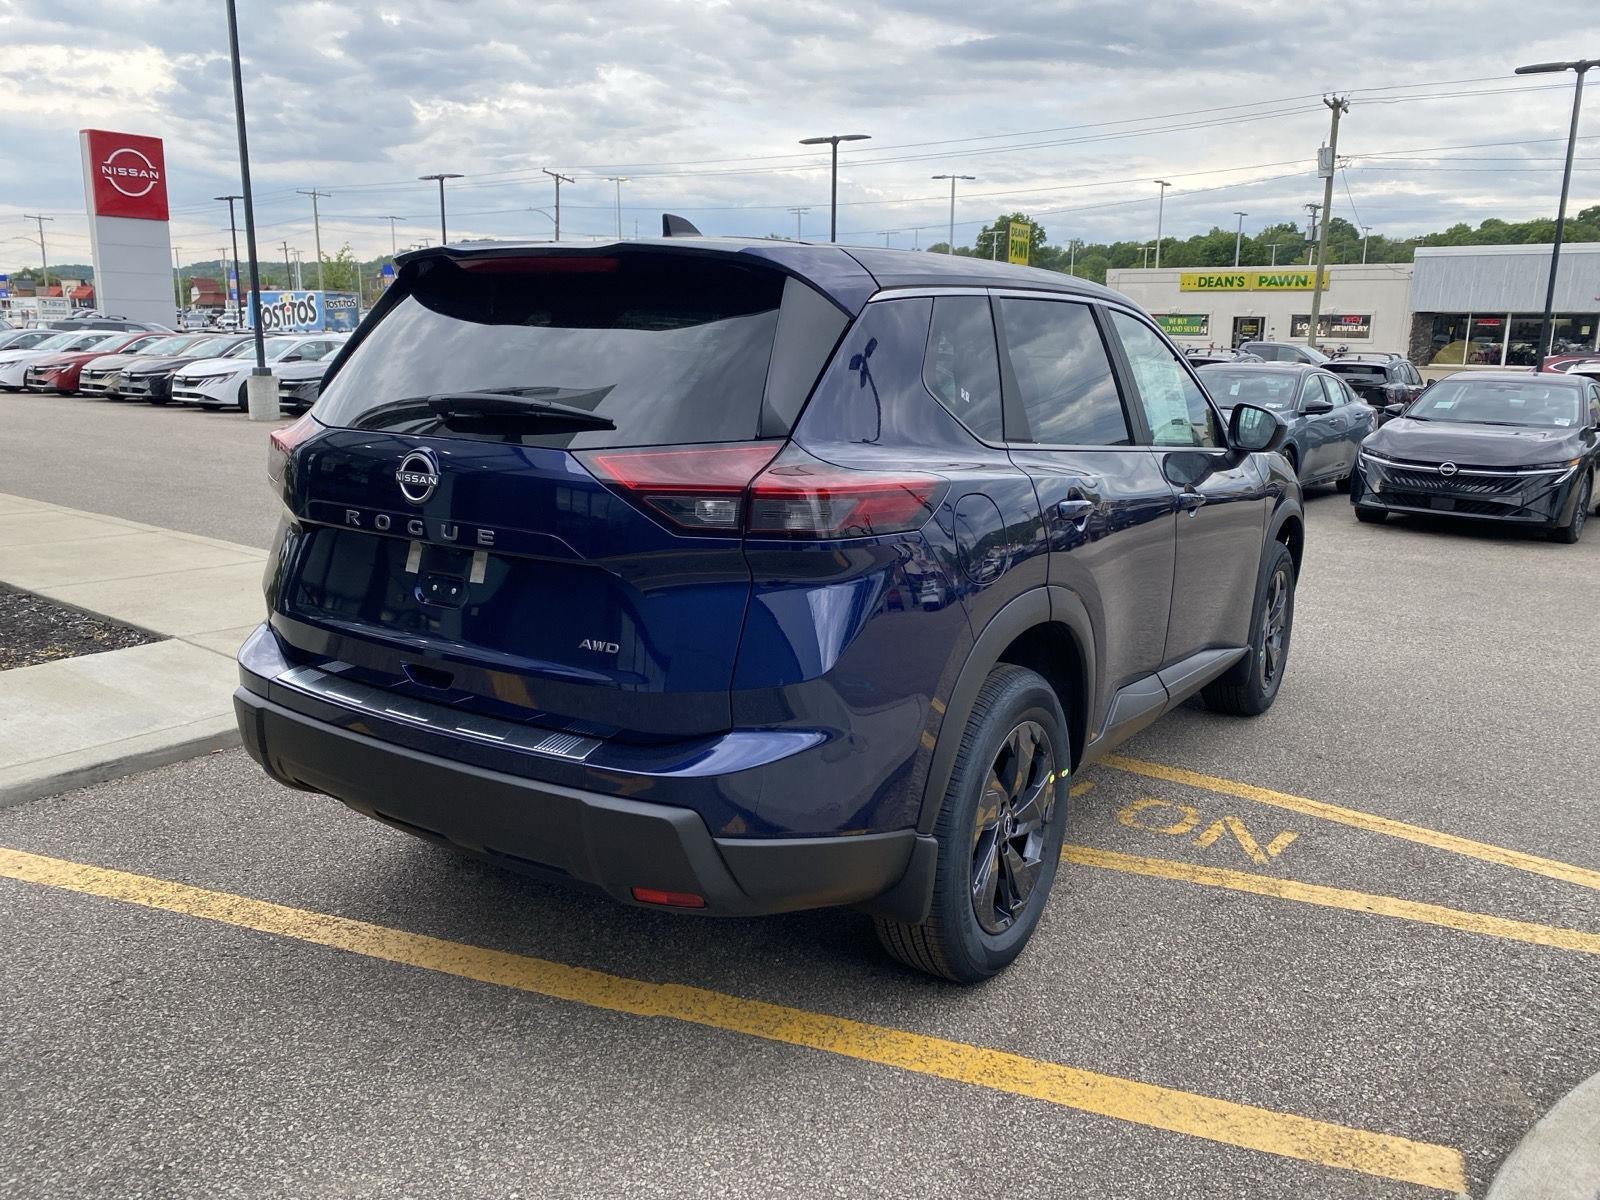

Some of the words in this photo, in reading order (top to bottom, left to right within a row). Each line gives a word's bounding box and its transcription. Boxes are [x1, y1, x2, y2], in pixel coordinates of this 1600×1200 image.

[101, 165, 159, 179] NISSAN
[1198, 276, 1245, 287] DEAN'S
[1258, 275, 1308, 287] PAWN
[260, 294, 317, 329] OSTITOS
[1168, 317, 1176, 325] WE
[1177, 317, 1187, 325] BUY
[395, 473, 437, 485] NISSAN
[345, 509, 495, 546] ROGUE
[578, 639, 619, 654] AWD
